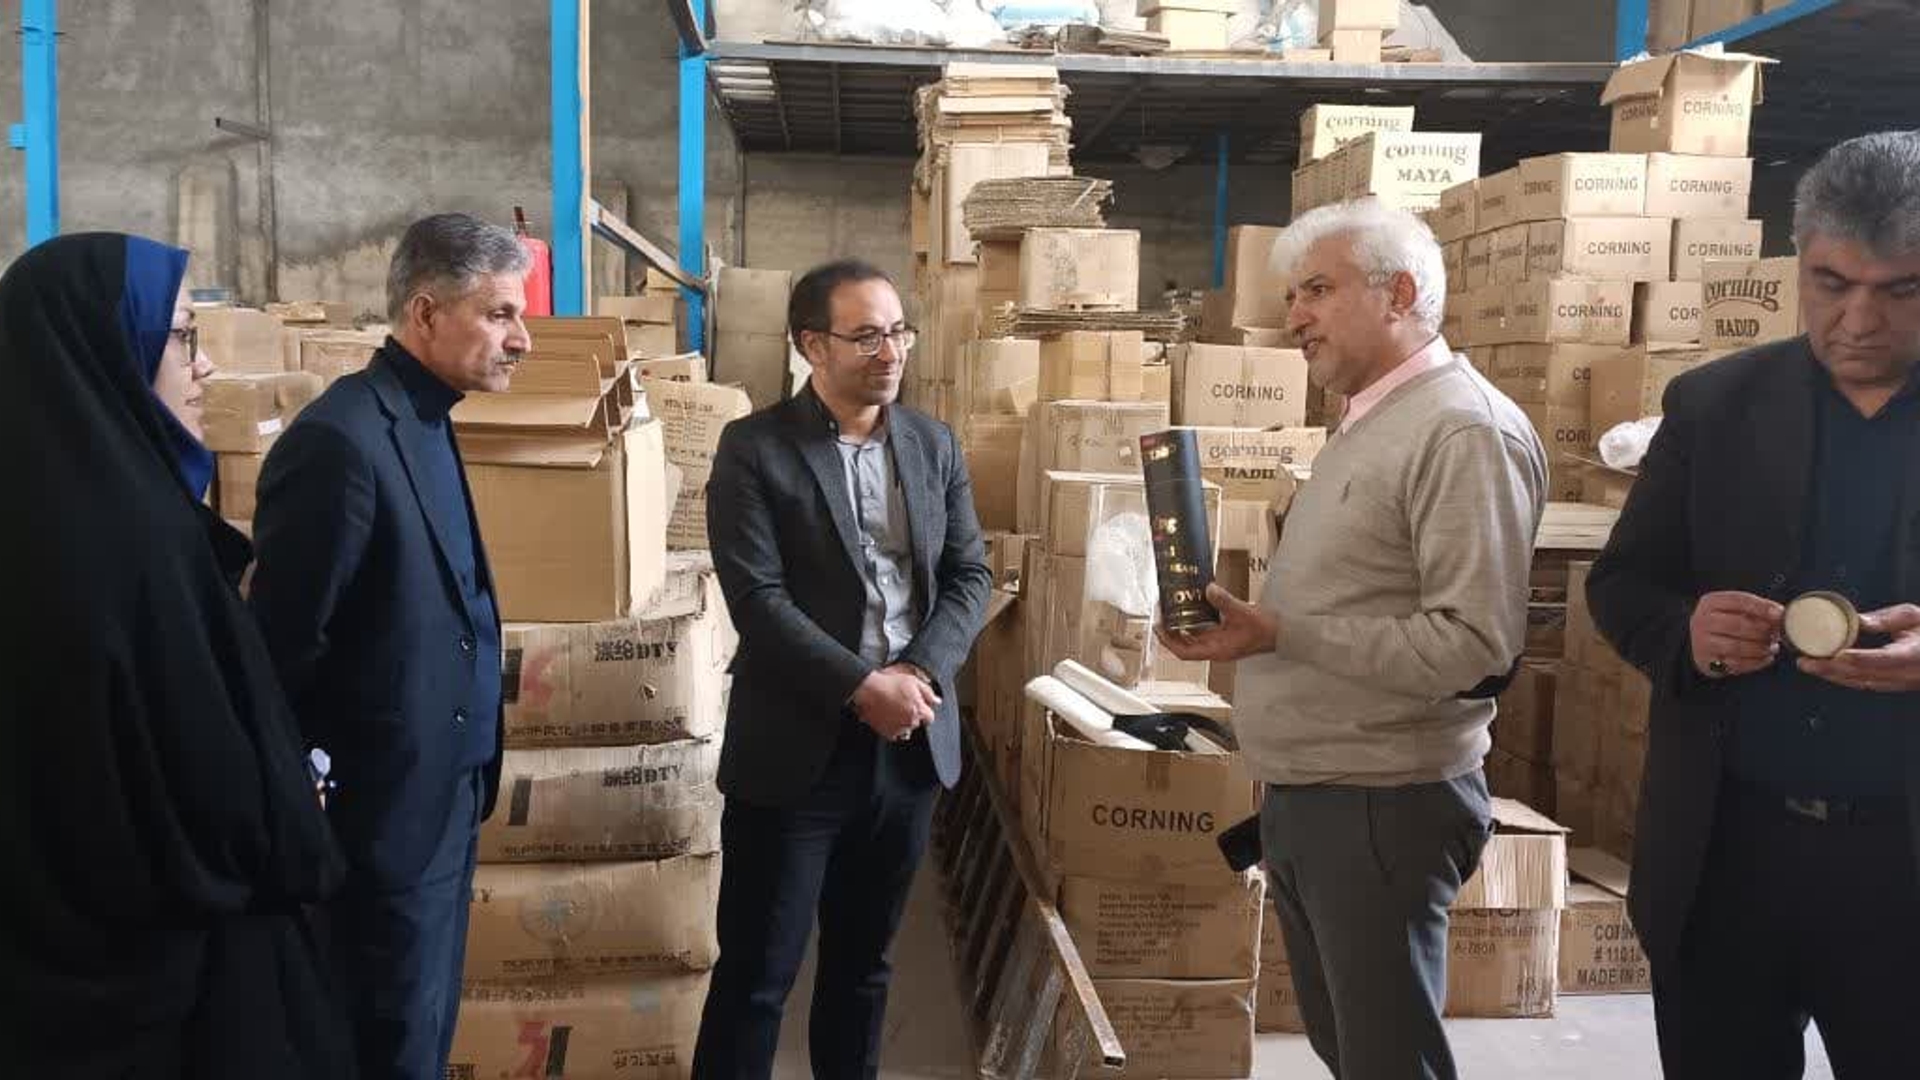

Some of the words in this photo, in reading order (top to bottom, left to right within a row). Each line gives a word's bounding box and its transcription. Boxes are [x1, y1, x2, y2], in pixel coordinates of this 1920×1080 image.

[1683, 101, 1744, 116] CORNING
[1397, 168, 1453, 182] MAYA
[1574, 177, 1639, 192] CORNING
[1669, 179, 1733, 195] CORNING
[1587, 241, 1651, 255] CORNING
[1687, 243, 1753, 257] CORNING
[1557, 303, 1623, 319] CORNING
[1211, 384, 1285, 401] CORNING
[1091, 803, 1216, 834] CORNING
[1577, 968, 1616, 987] MADE
